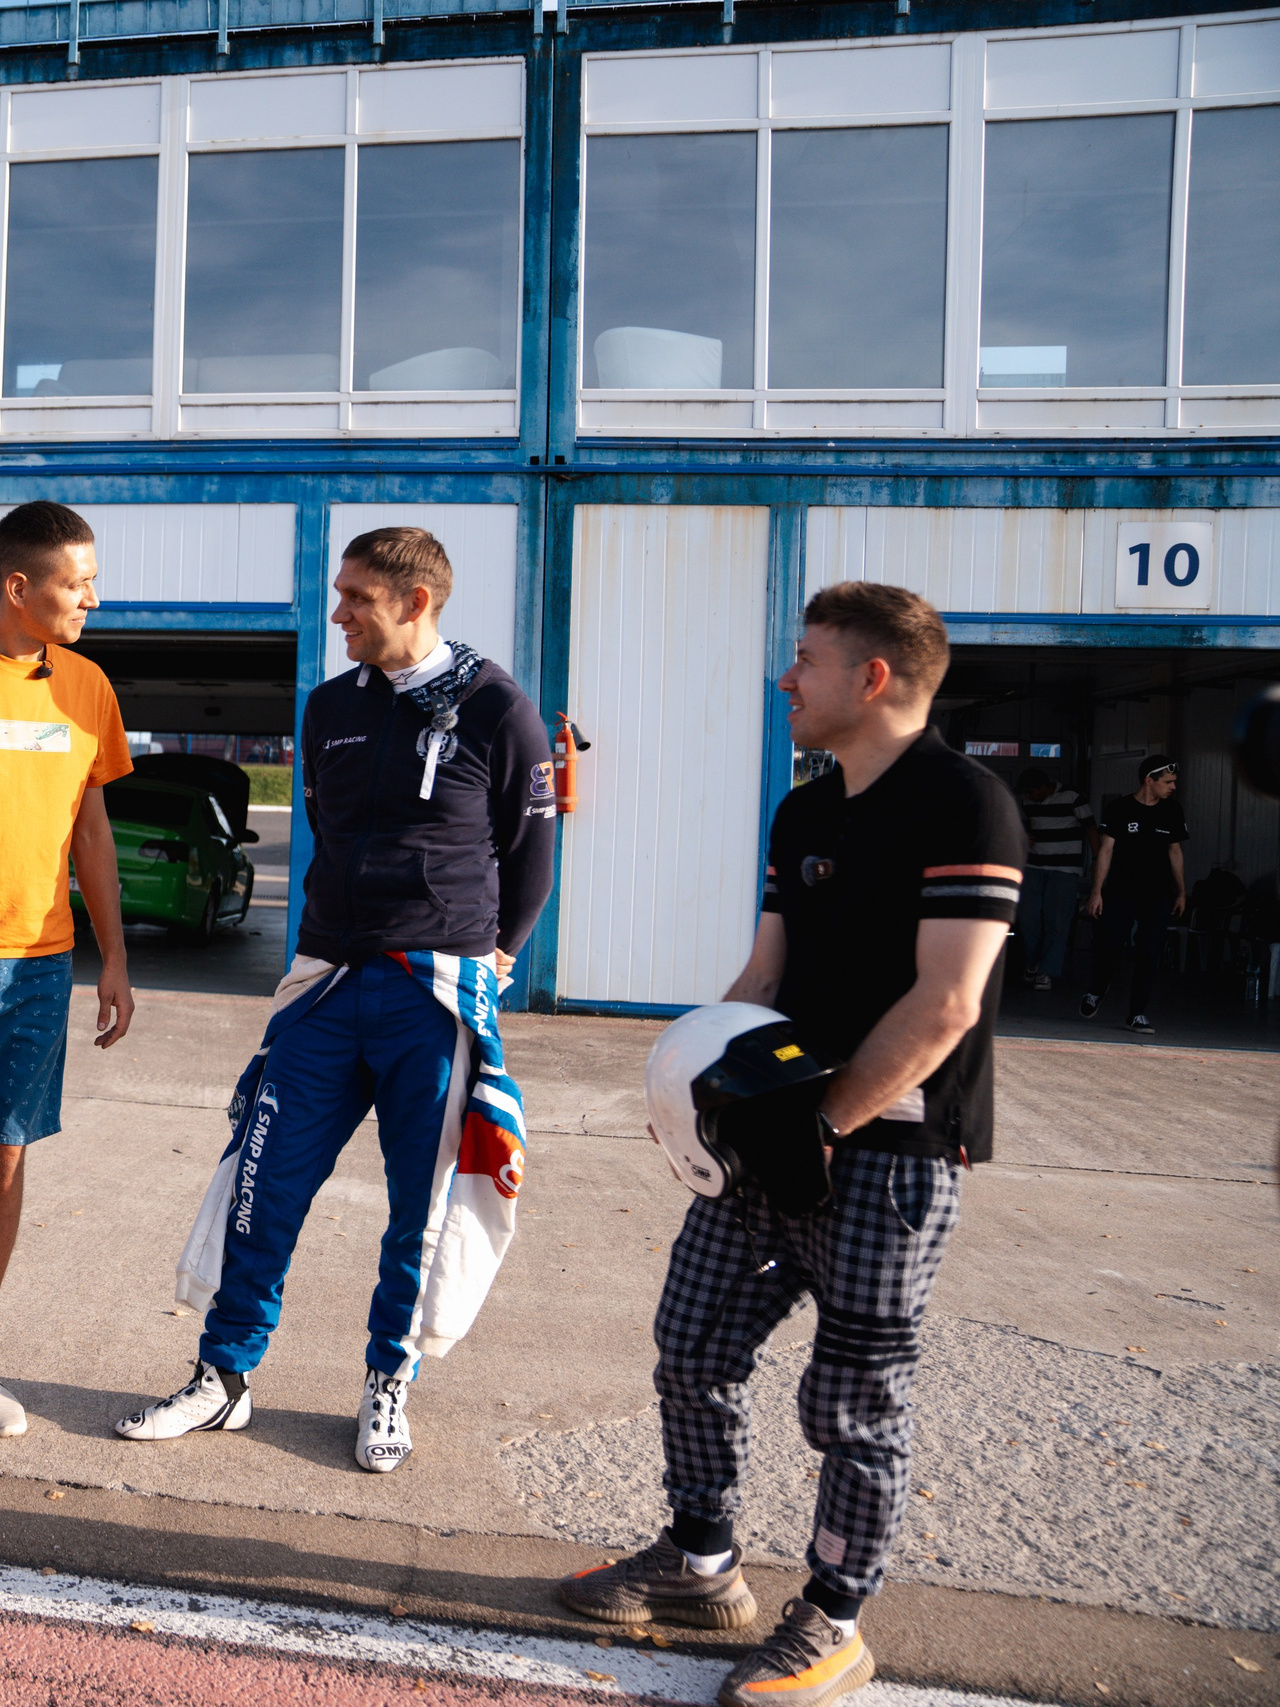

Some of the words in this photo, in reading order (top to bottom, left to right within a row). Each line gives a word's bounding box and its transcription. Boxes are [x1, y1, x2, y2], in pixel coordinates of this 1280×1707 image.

[1128, 542, 1200, 588] 10
[342, 735, 368, 745] RACING
[248, 1109, 271, 1159] SMP
[235, 1158, 259, 1235] RACING
